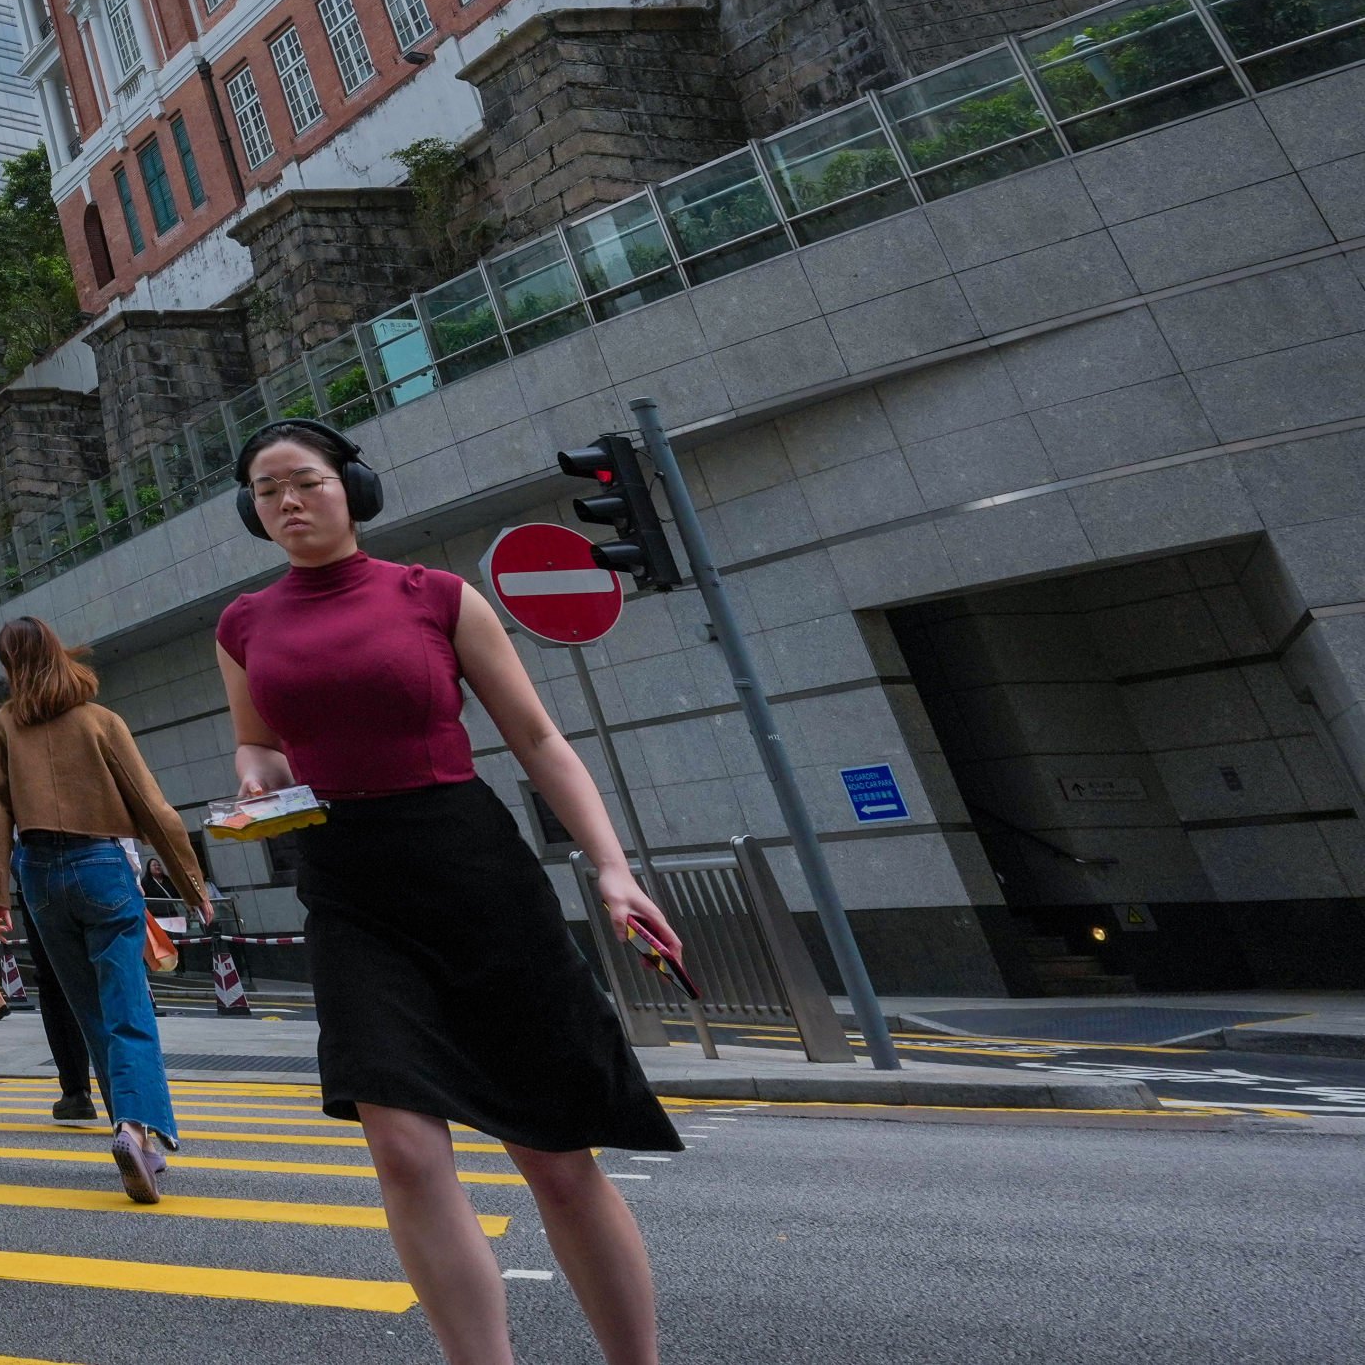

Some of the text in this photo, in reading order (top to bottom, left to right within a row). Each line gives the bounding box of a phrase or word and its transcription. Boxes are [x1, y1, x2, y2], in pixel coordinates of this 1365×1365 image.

[844, 772, 880, 783] TO GARDEN
[847, 779, 895, 791] ROAD CAR PARK
